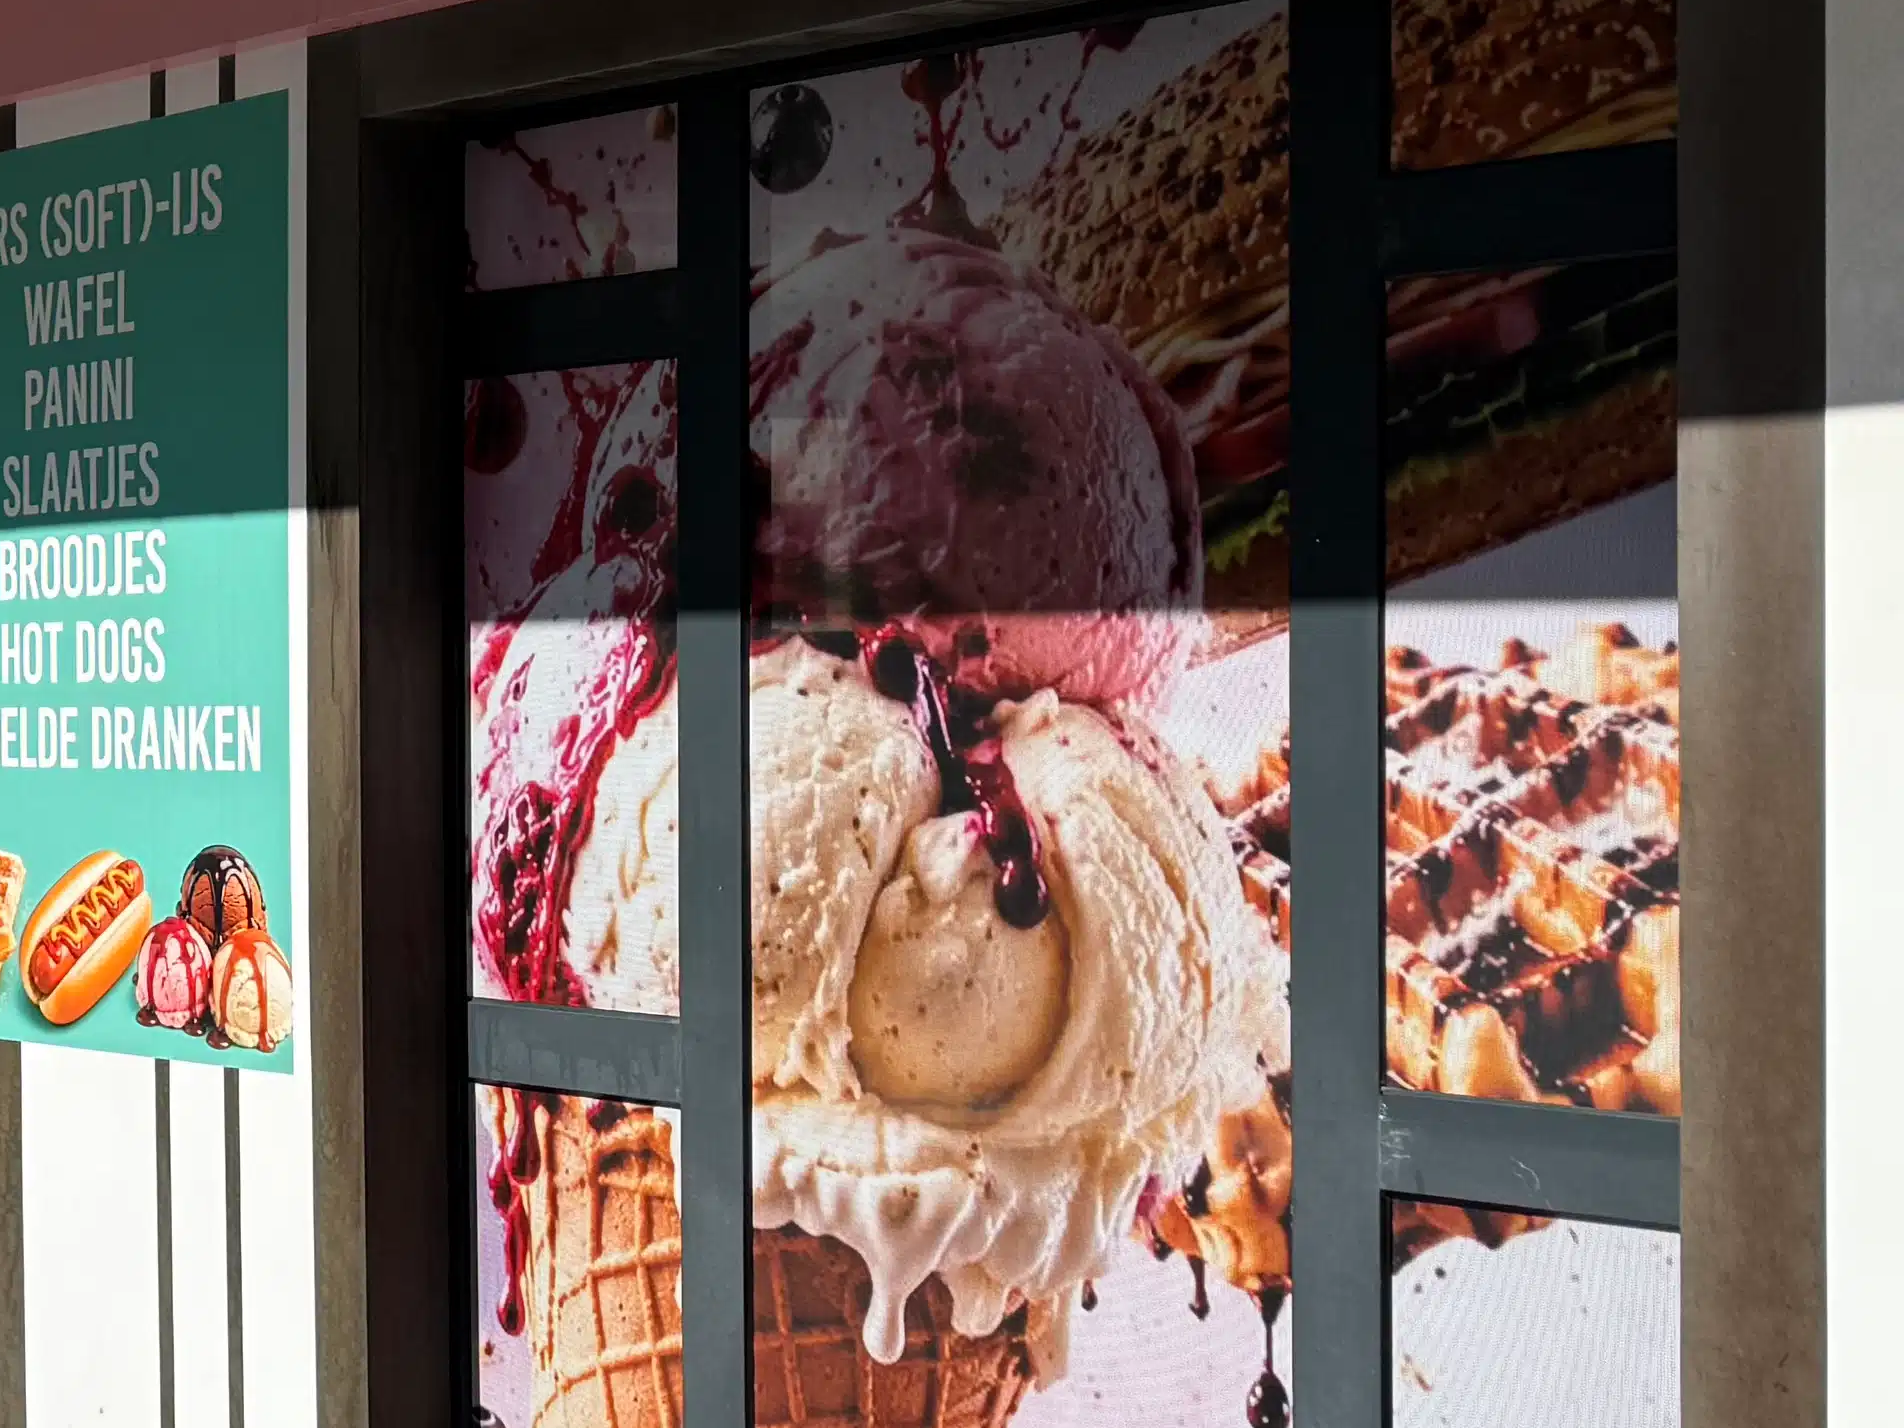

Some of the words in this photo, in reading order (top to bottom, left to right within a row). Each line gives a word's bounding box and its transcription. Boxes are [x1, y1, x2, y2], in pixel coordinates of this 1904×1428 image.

[41, 164, 224, 260] (SOFT)-IJS
[24, 271, 135, 346] WAFEL
[24, 357, 134, 430] PANINI
[3, 442, 160, 517] SLAATJES
[1, 621, 64, 685] HOT
[76, 617, 167, 683] DOGS
[92, 704, 262, 772] DRANKEN
